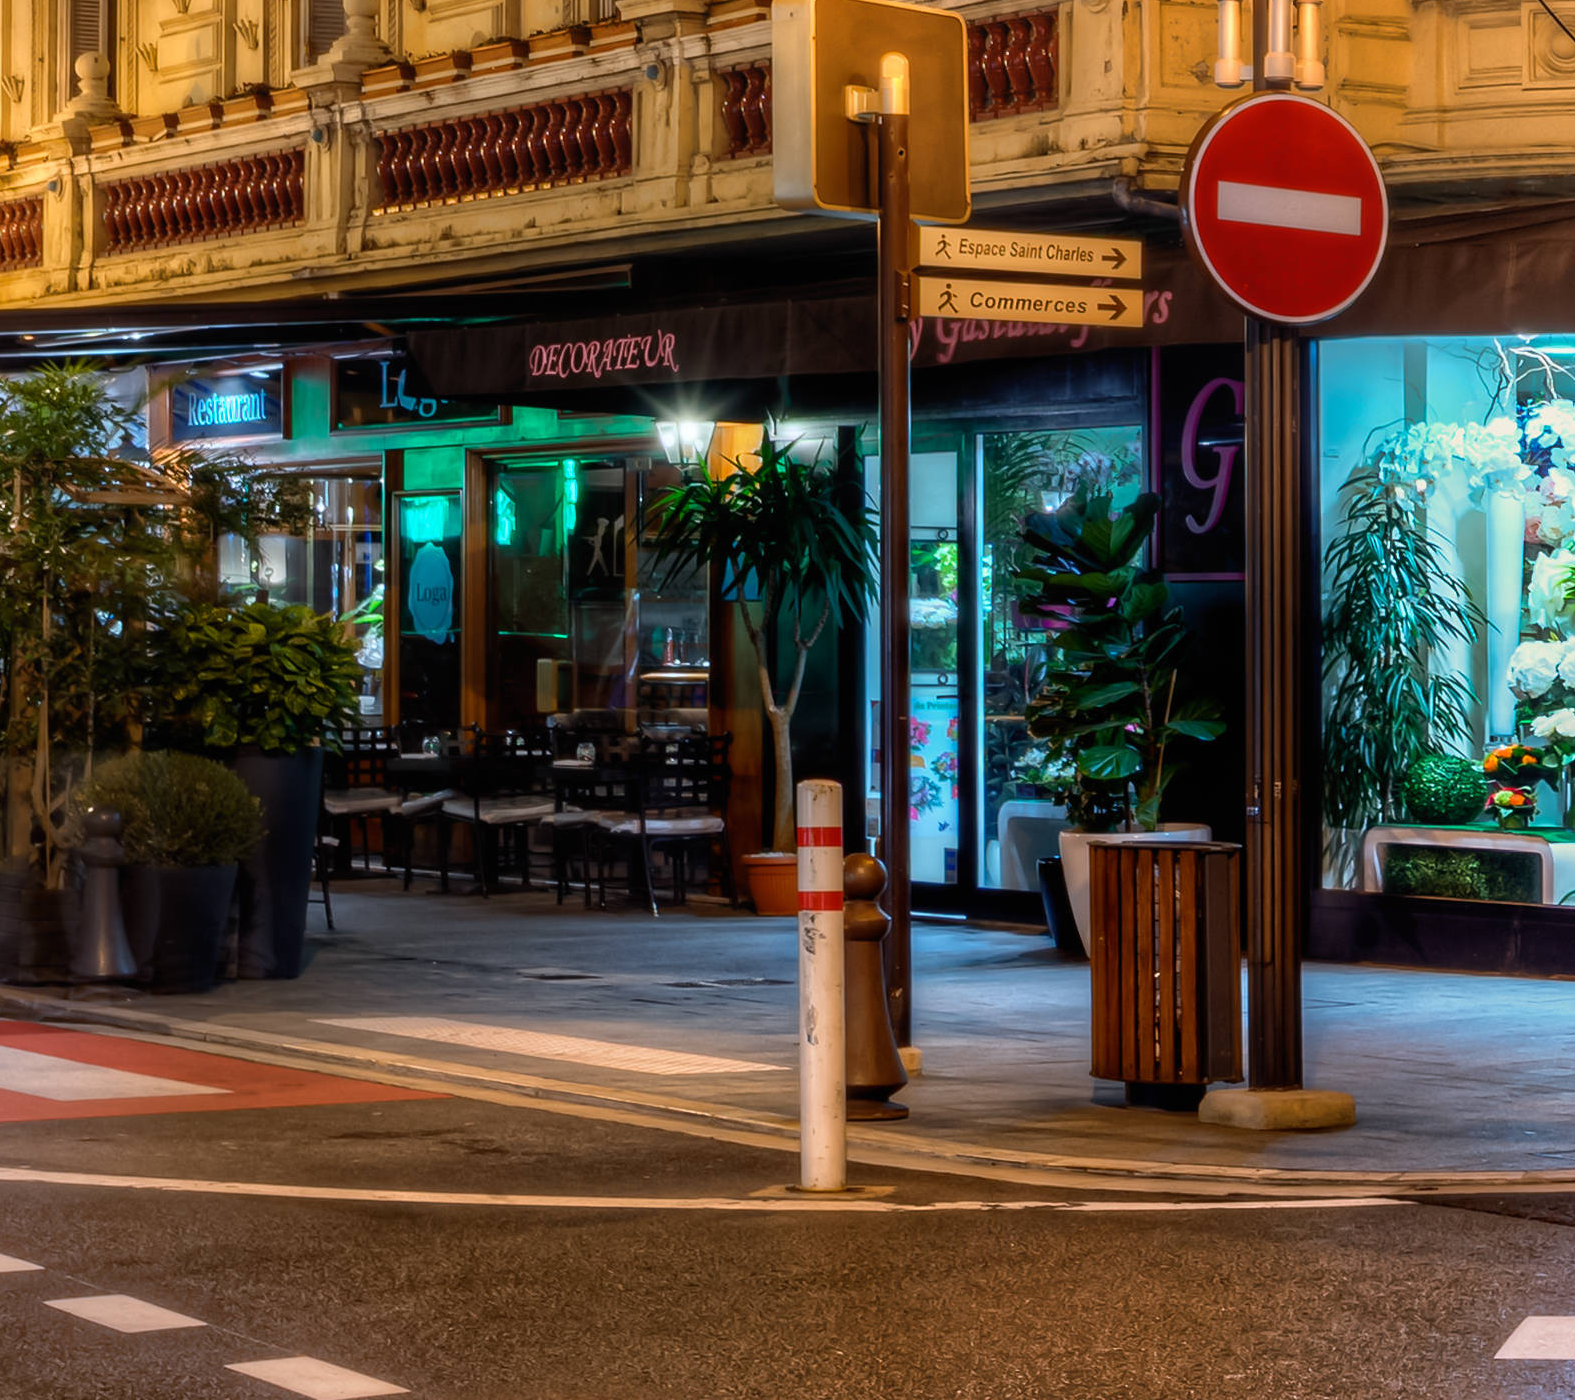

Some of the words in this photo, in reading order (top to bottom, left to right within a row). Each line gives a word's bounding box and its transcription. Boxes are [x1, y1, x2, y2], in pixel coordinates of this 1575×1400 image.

[958, 238, 1006, 260] Espace
[1009, 241, 1043, 260] Saint
[1045, 244, 1094, 264] Charles
[970, 291, 1088, 314] Commerces
[529, 329, 679, 378] DECORATEUR
[416, 582, 447, 606] Loga
